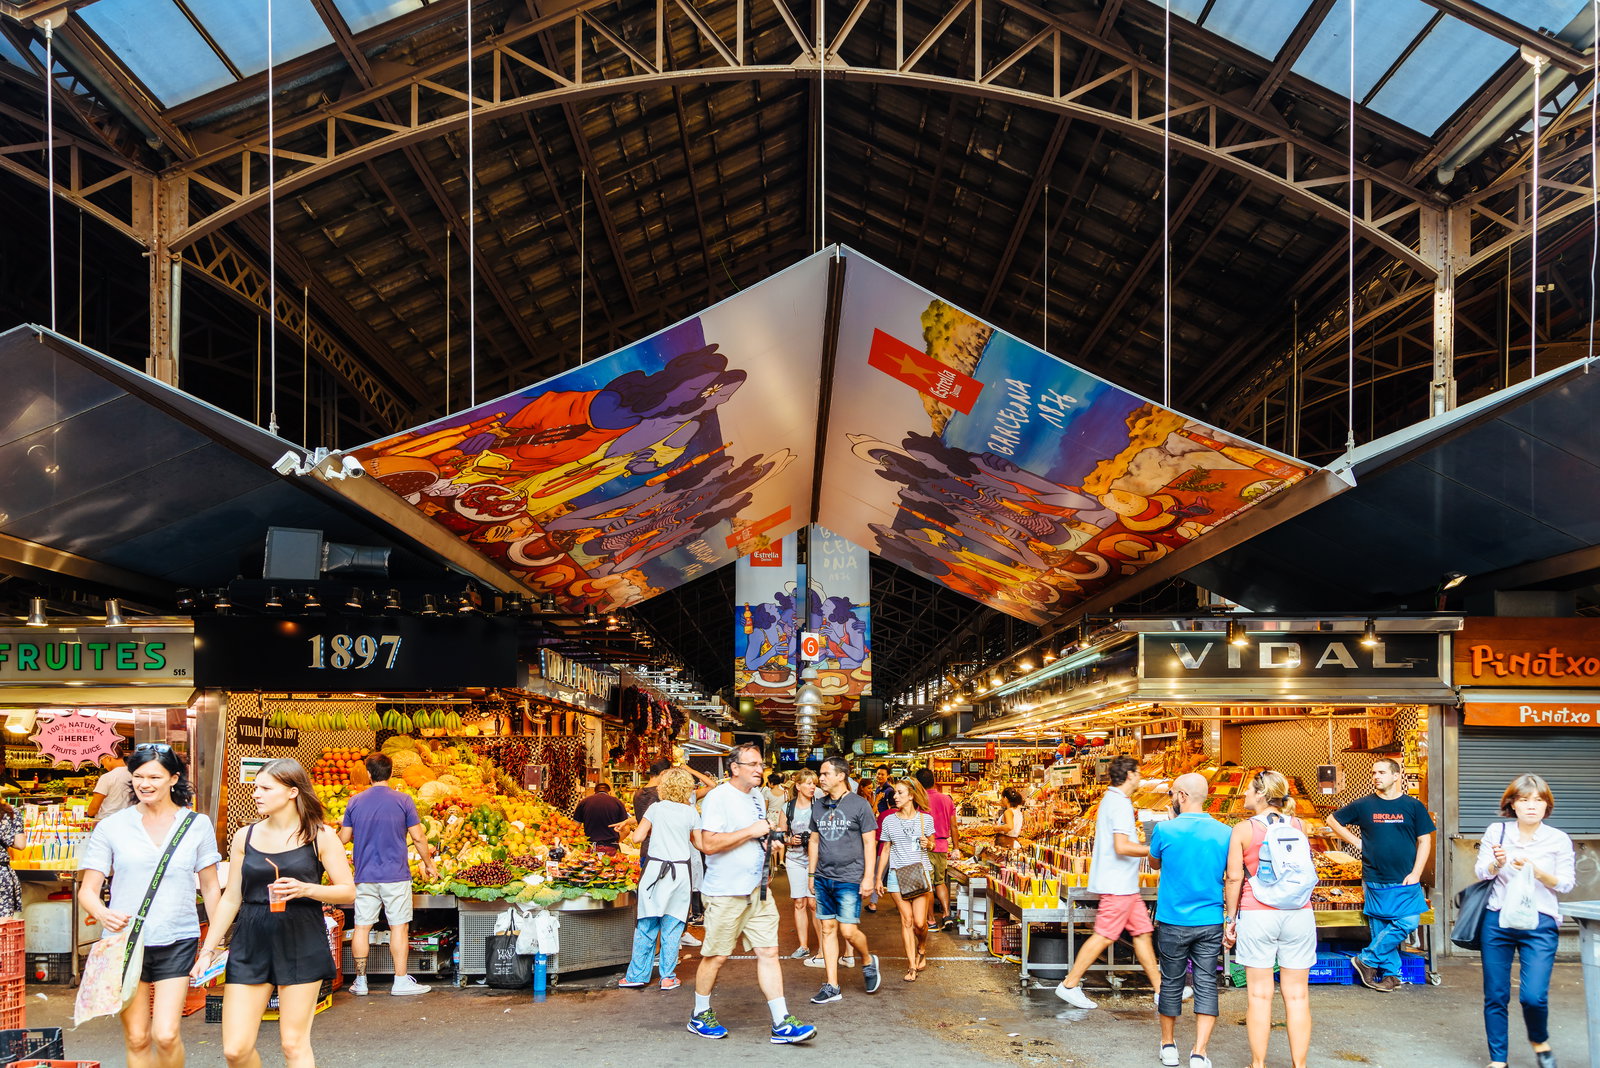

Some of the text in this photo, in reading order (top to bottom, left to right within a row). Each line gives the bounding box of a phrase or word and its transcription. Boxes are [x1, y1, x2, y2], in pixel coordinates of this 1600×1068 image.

[929, 369, 956, 399] Estrella
[987, 378, 1032, 456] BARCELONA
[1037, 388, 1078, 429] 1876
[753, 551, 779, 559] Estrella
[0, 642, 166, 671] FRUITES
[307, 633, 402, 670] 1897
[807, 640, 814, 653] 6
[1170, 642, 1413, 668] VIDAL
[47, 723, 66, 735] 100%
[68, 721, 105, 736] NATURAL
[239, 725, 297, 740] VIDAL PONS 1897
[51, 744, 77, 756] FRUITS
[80, 744, 102, 756] JUICE
